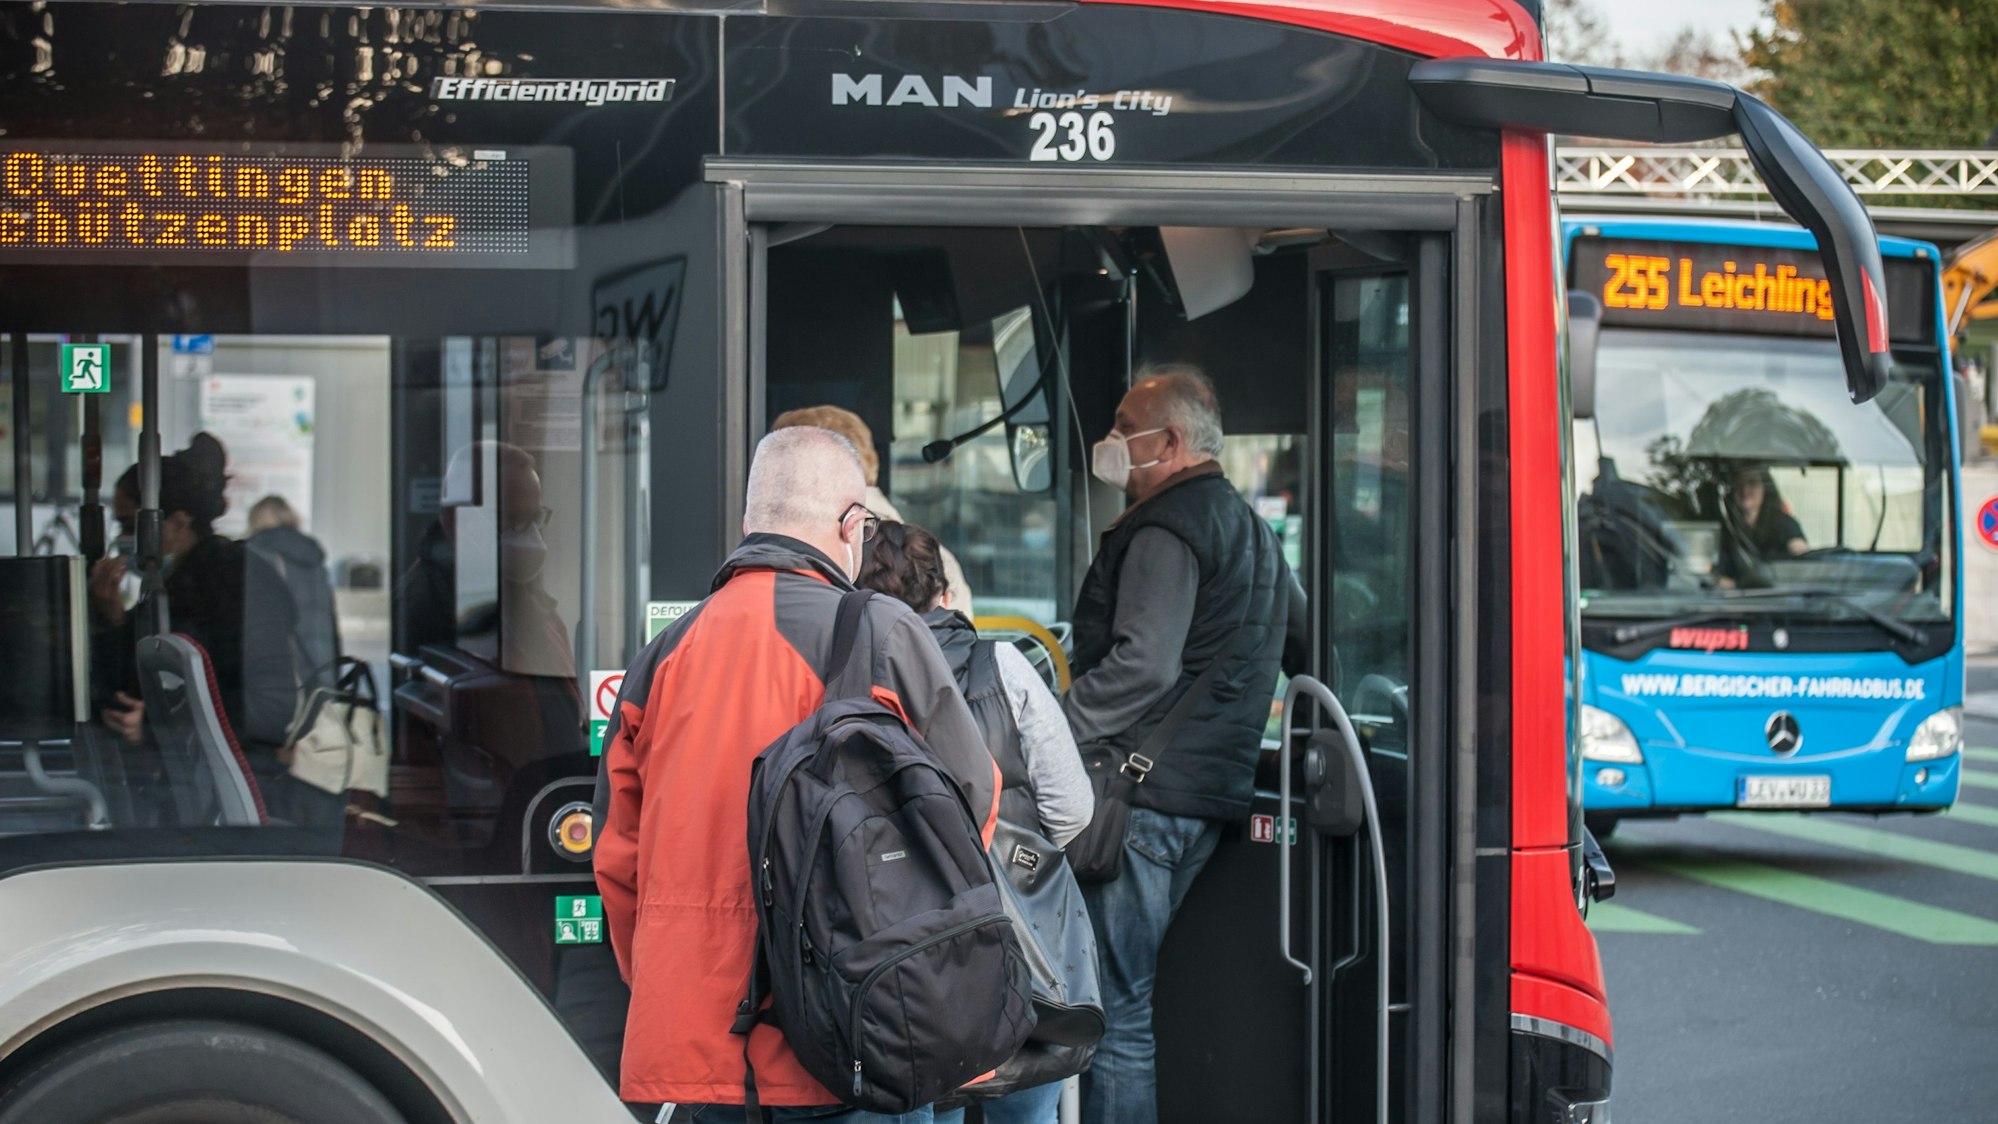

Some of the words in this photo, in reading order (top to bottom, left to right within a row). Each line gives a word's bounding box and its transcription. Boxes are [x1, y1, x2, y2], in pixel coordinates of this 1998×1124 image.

[437, 79, 668, 106] EfficientHybrid
[832, 73, 992, 108] MAN
[1013, 88, 1100, 110] Lion's
[1113, 90, 1172, 116] City
[1029, 111, 1116, 162] 236
[6, 153, 391, 204] Quettingen
[1603, 253, 1671, 310] 255
[1678, 257, 1835, 320] Leichling
[1669, 624, 1748, 653] wupsi
[1621, 673, 1926, 699] WWW.BERGISCHER-FAHRRADBUS.DE
